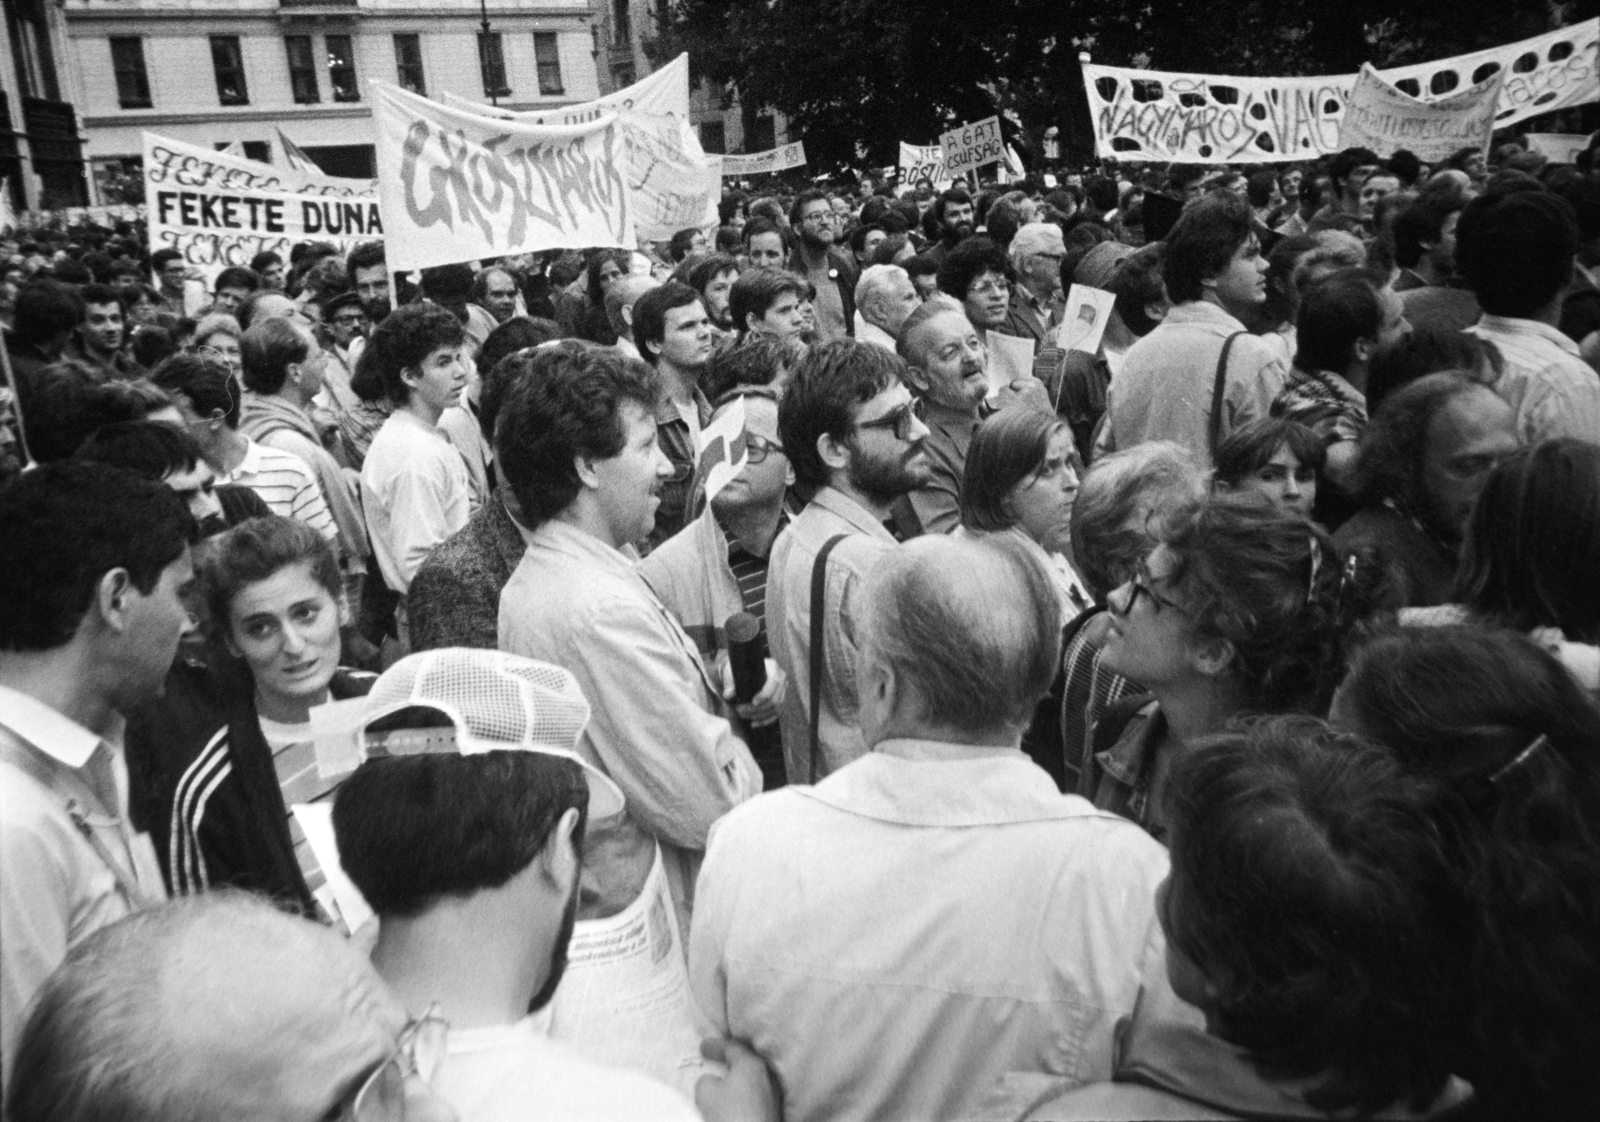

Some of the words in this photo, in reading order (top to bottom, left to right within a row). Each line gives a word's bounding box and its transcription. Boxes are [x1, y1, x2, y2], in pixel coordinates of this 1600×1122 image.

[946, 135, 958, 150] A
[919, 147, 941, 160] NE
[156, 190, 285, 233] FEKETE
[301, 200, 384, 235] DUNA
